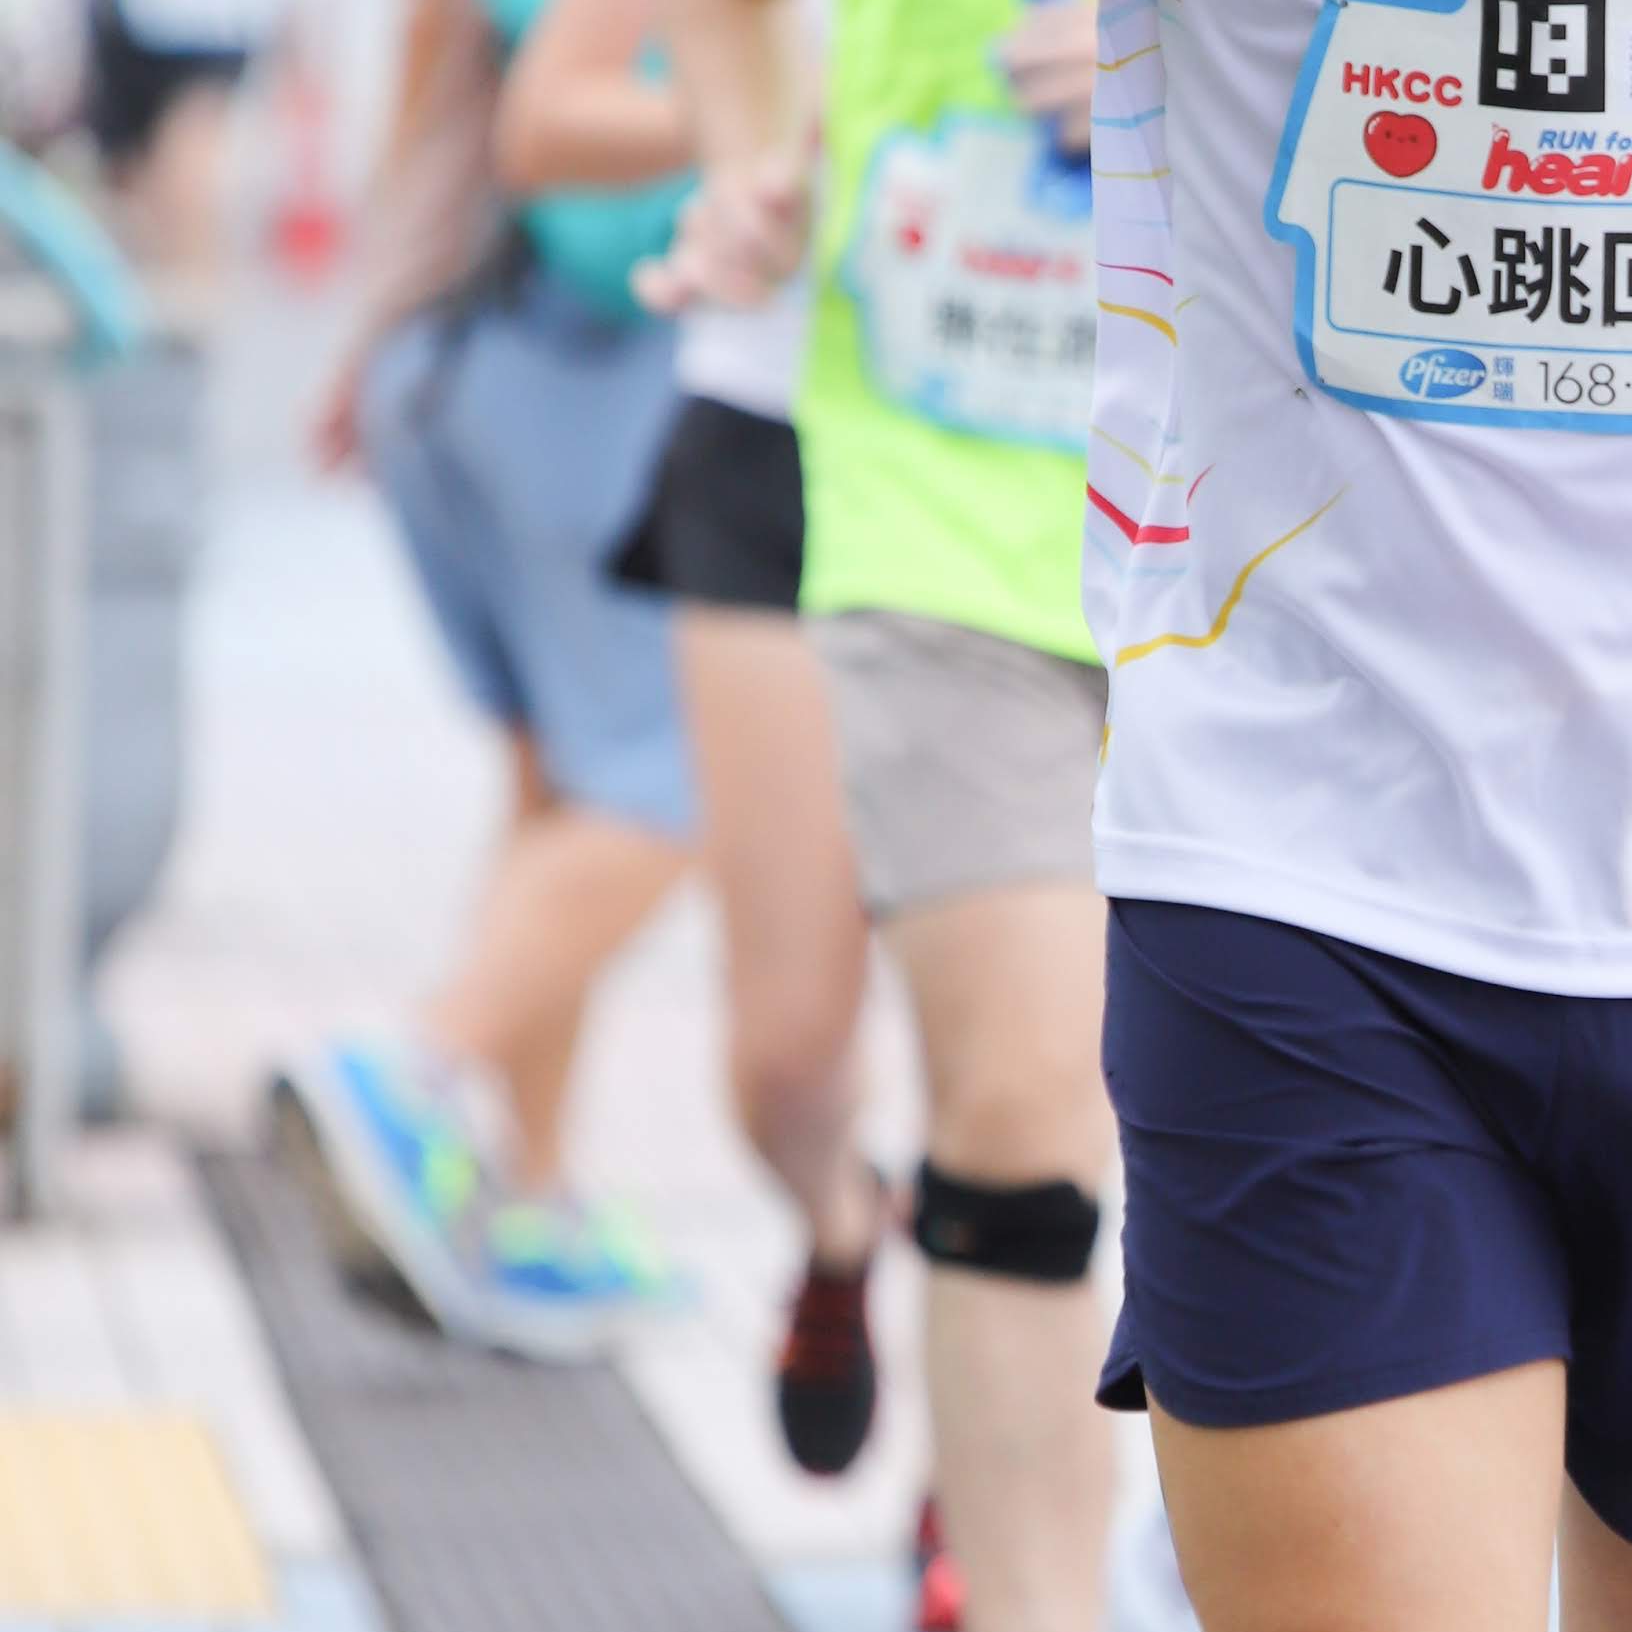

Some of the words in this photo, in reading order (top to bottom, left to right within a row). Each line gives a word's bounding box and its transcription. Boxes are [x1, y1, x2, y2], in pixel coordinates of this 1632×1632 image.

[1342, 61, 1463, 107] HKCC
[1537, 130, 1597, 151] RUN
[1404, 352, 1487, 399] Pfizer
